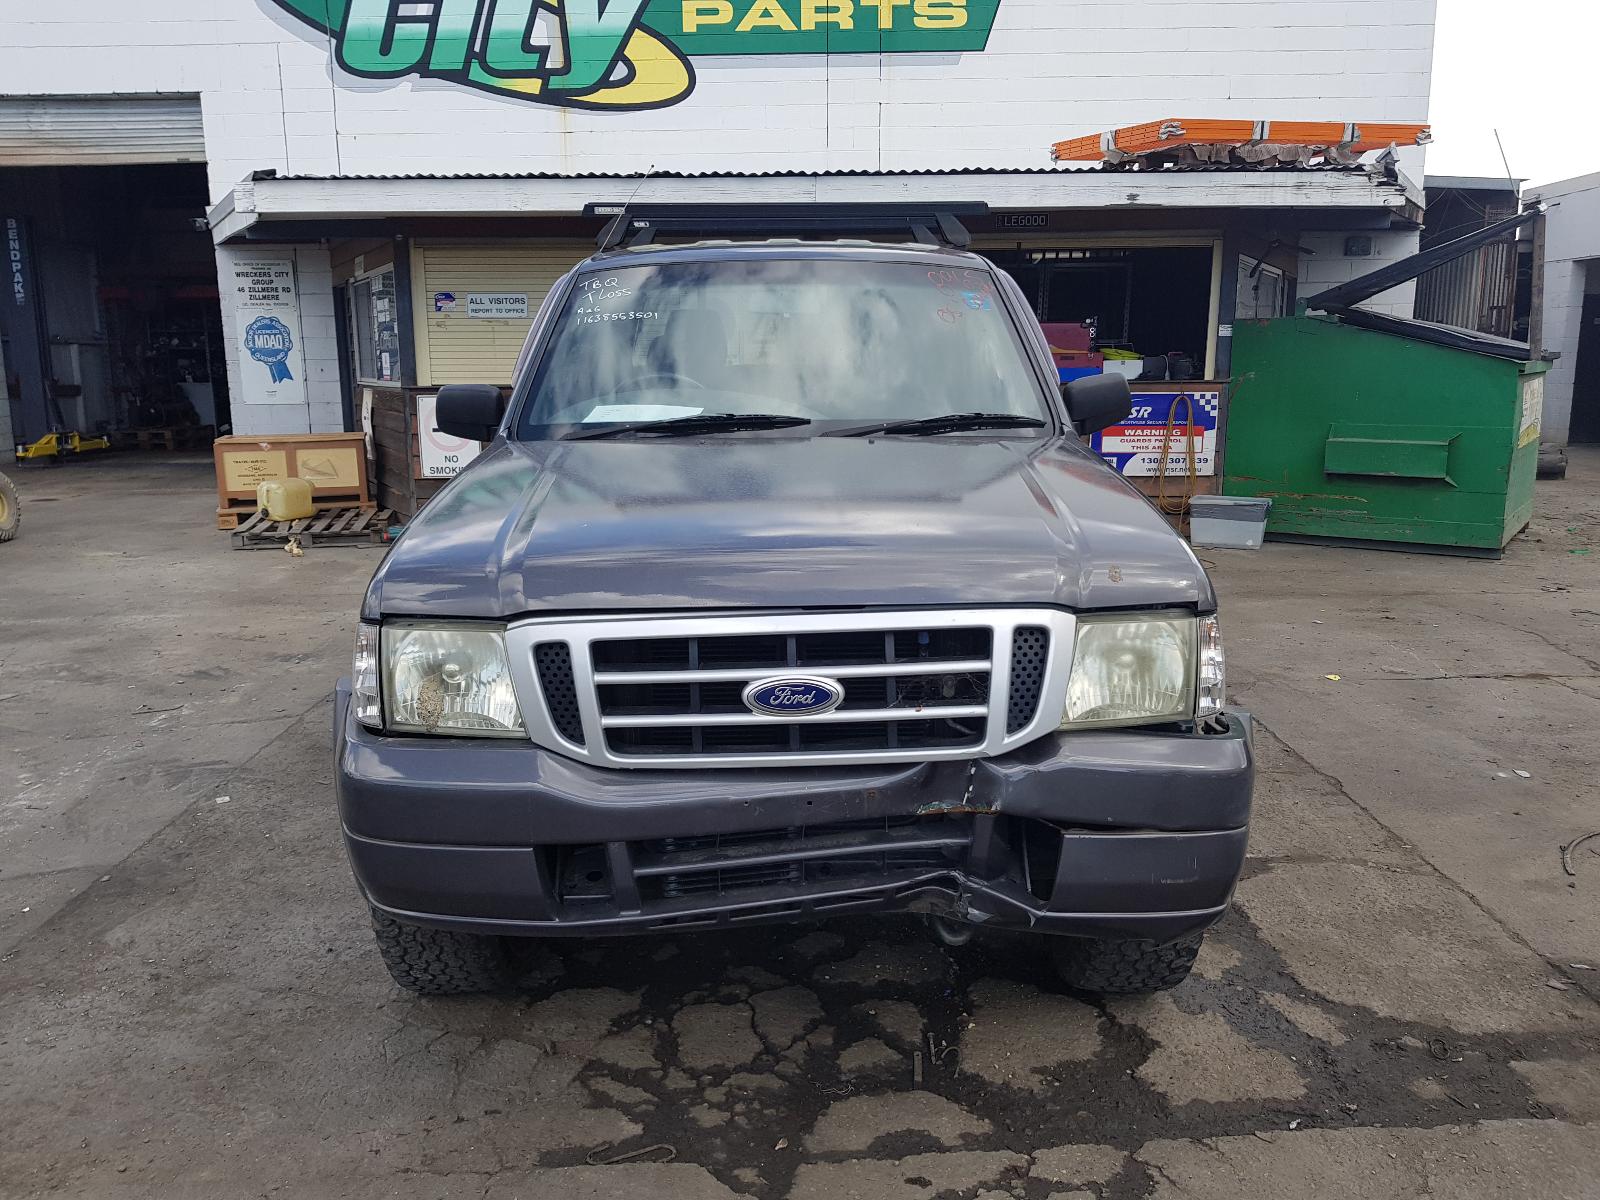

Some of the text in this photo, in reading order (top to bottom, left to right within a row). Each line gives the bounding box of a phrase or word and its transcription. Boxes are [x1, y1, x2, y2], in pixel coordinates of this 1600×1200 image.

[681, 0, 968, 32] PARTS
[469, 297, 526, 305] ALL VISITORS
[254, 334, 283, 349] MDAQ
[1128, 406, 1152, 418] SR
[444, 455, 459, 463] NO
[769, 686, 816, 705] Ford
